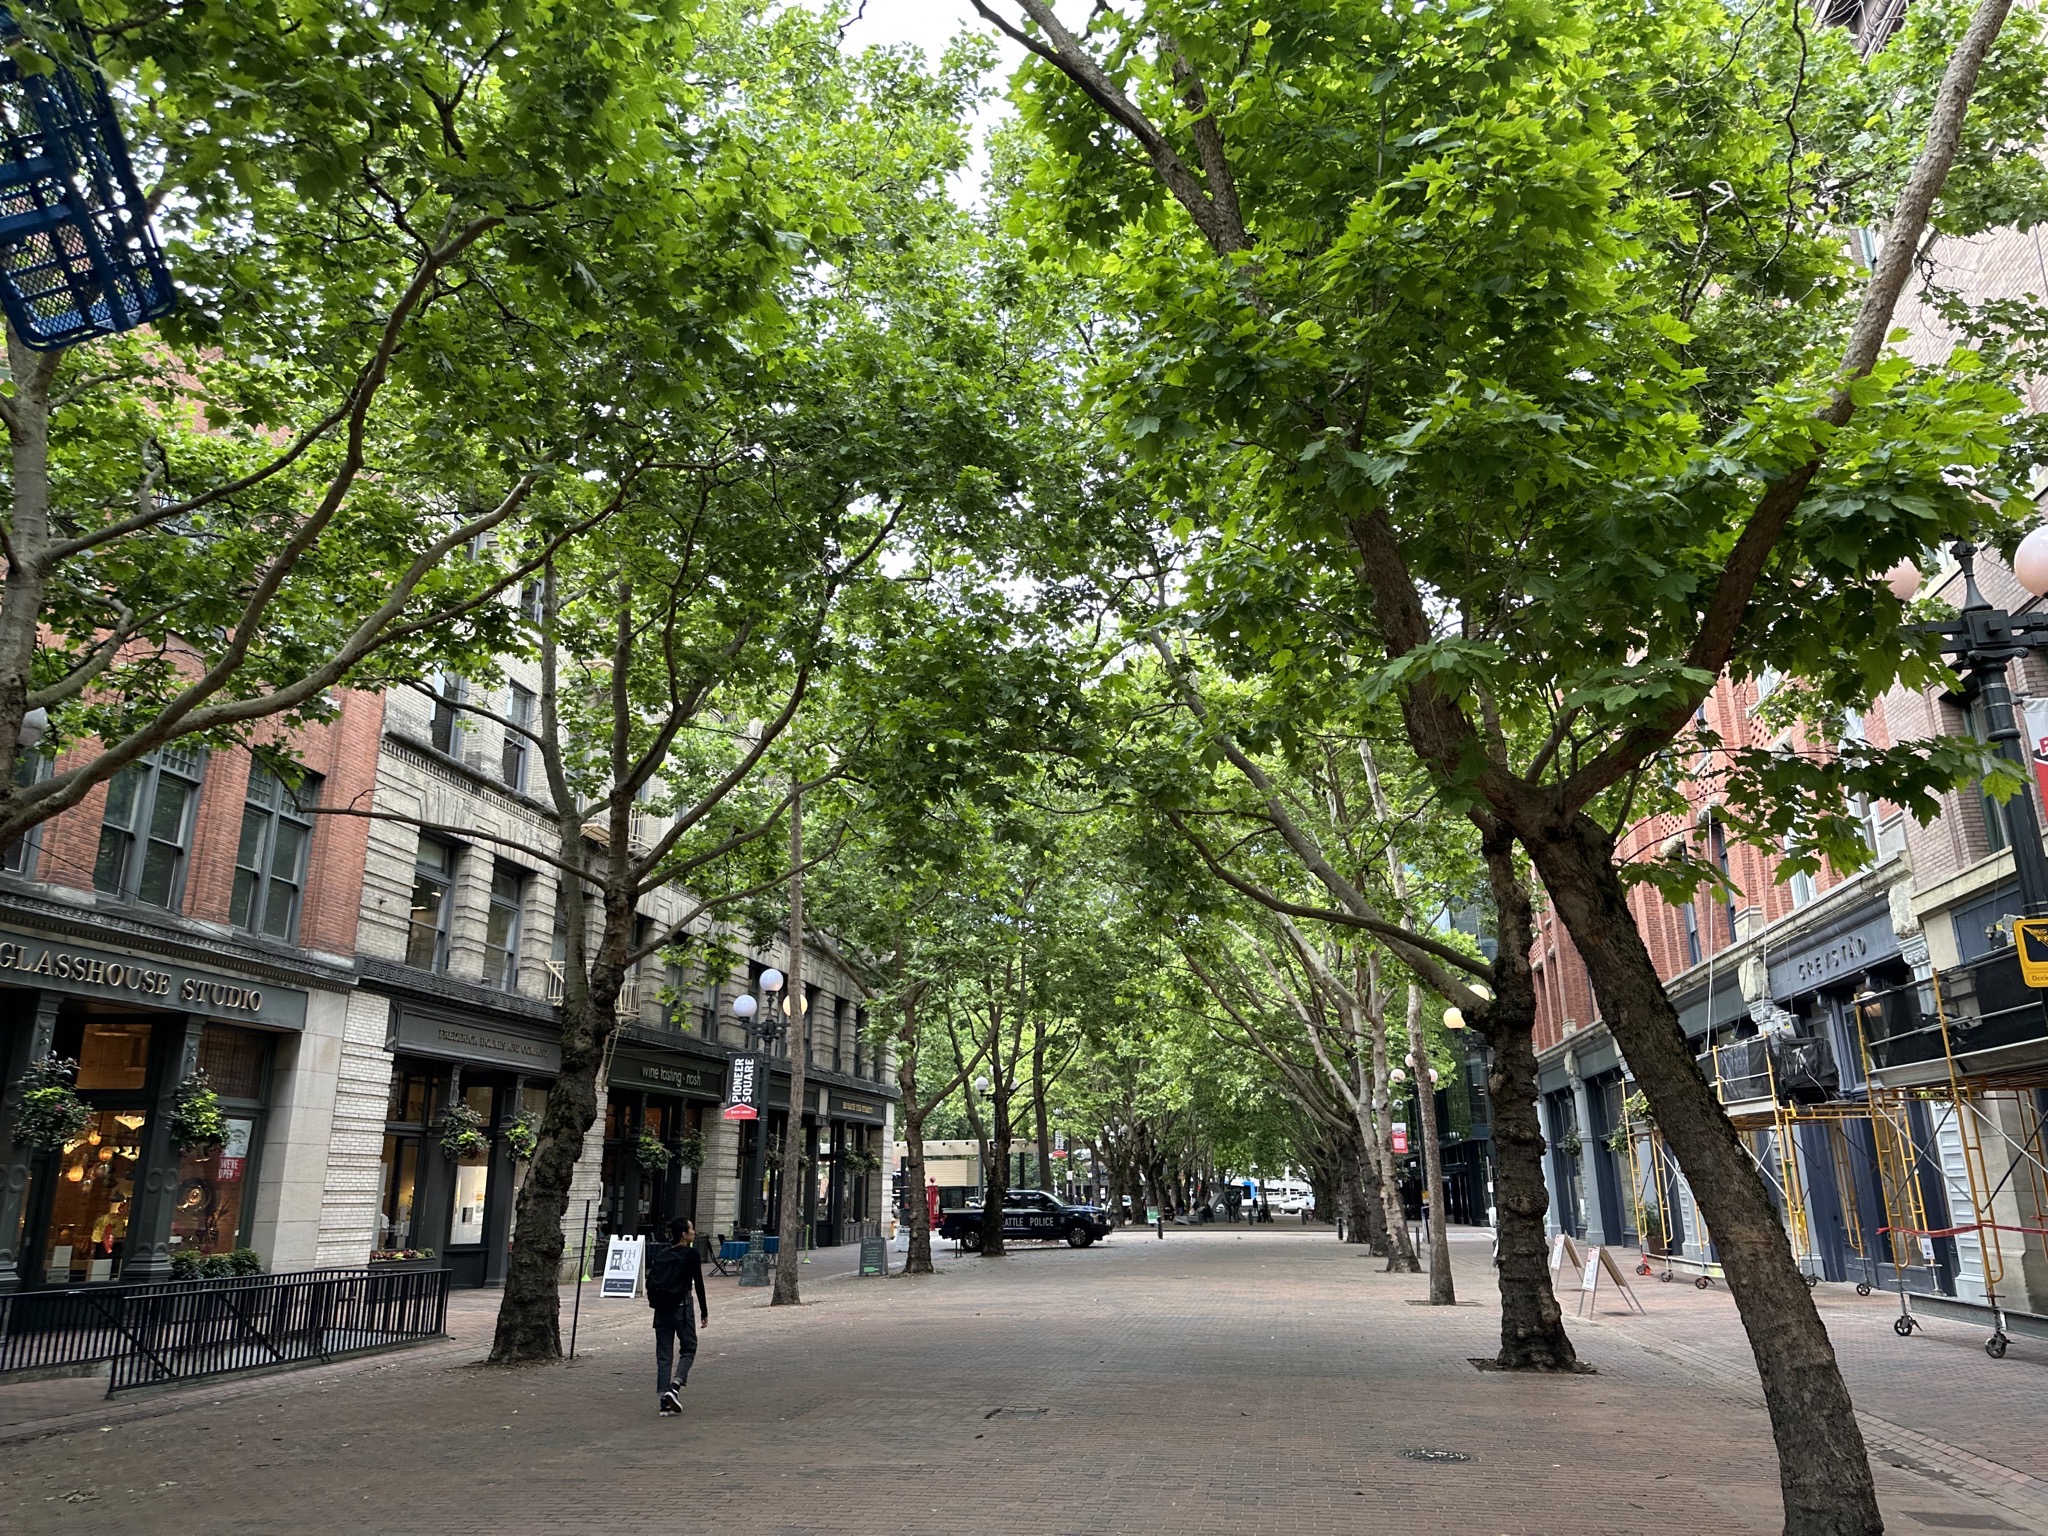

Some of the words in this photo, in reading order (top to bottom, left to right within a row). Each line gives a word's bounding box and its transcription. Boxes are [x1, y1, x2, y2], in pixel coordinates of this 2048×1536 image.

[0, 942, 172, 996] GLASSHOUSE
[180, 977, 264, 1012] STUDIO
[641, 1066, 659, 1080] wine
[660, 1066, 682, 1088] tasting
[686, 1069, 701, 1086] nosh
[731, 1058, 745, 1103] PIONEER
[742, 1058, 755, 1103] SQUARE
[218, 1169, 234, 1179] OPEN
[1002, 1217, 1024, 1227] ATTLE
[1029, 1216, 1054, 1227] POLICE
[624, 1249, 637, 1259] FH
